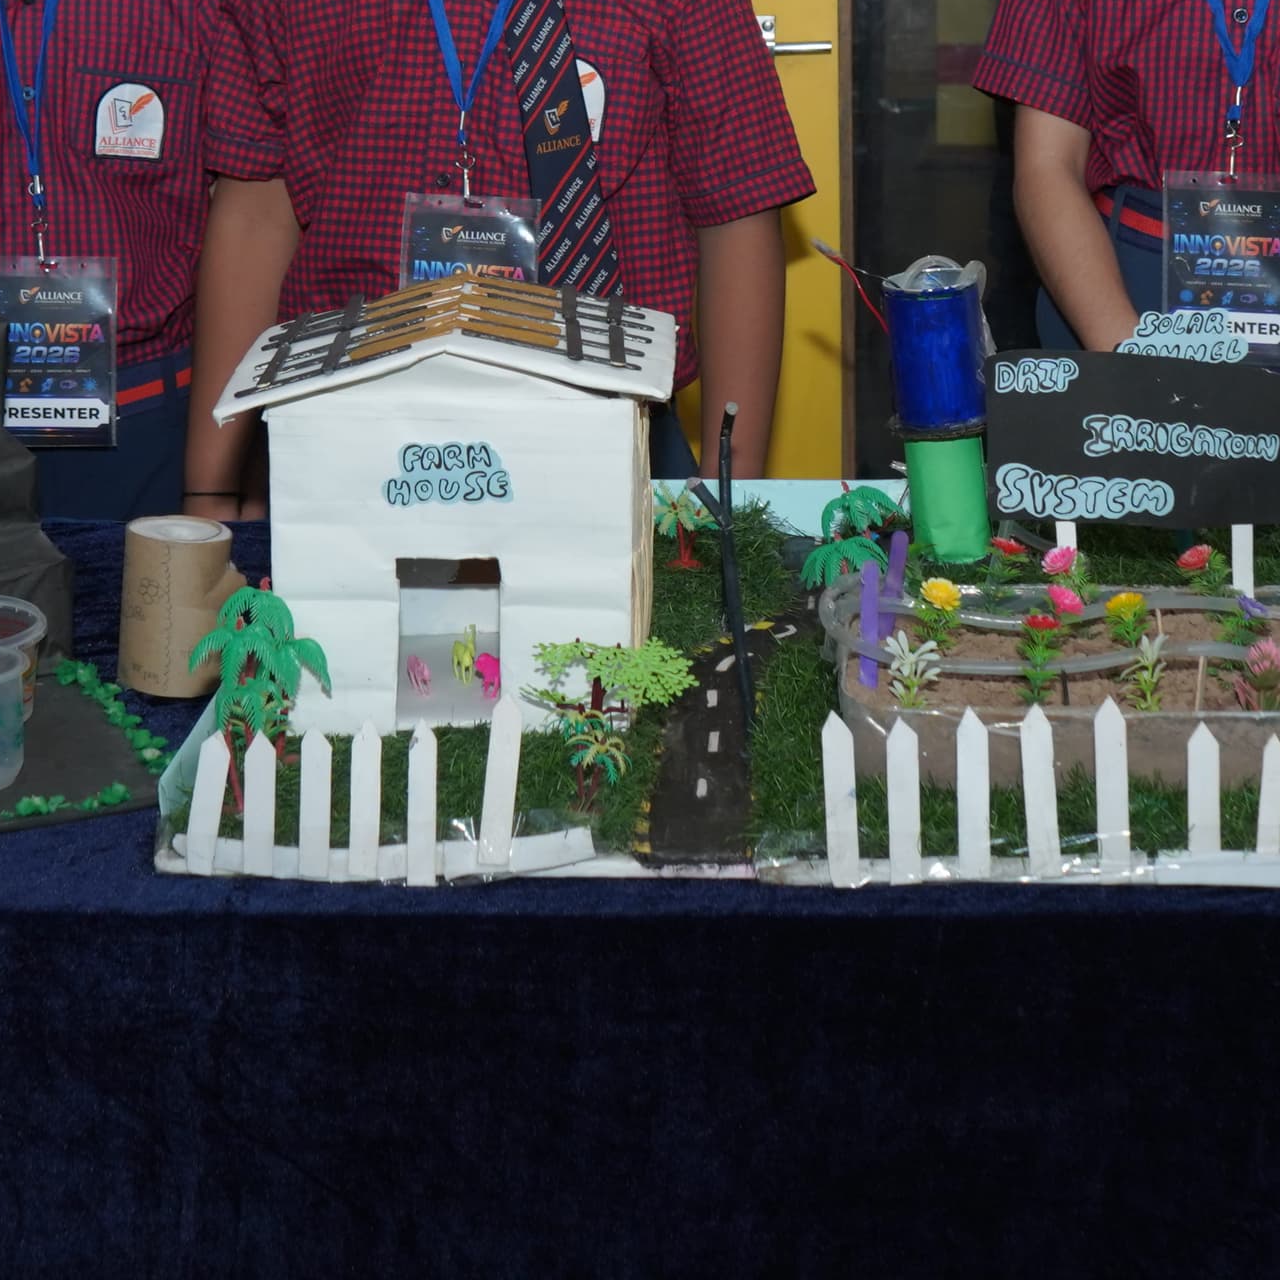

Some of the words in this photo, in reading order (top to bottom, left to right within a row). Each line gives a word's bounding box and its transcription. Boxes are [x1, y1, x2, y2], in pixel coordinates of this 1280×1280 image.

[513, 1, 537, 37] ALLIANCE
[531, 16, 555, 53] ALLIANCE
[522, 76, 548, 112] ALLIANCE
[100, 136, 157, 149] ALLIANCE
[535, 134, 582, 155] ALLIANCE
[557, 177, 583, 214] ALLIANCE
[1214, 203, 1263, 215] ALLIANCE
[575, 194, 600, 230] ALLIANCE
[457, 231, 507, 242] ALLIANCE
[545, 238, 572, 273] ALLIANCE
[1194, 257, 1261, 277] 2026
[35, 291, 84, 301] ALLIANCE
[1137, 311, 1225, 339] SOLAR
[13, 345, 81, 364] 2026
[996, 360, 1077, 393] DRIP
[403, 444, 492, 473] FARM
[387, 470, 509, 506] HOUSE
[997, 467, 1170, 516] SYSTEM
